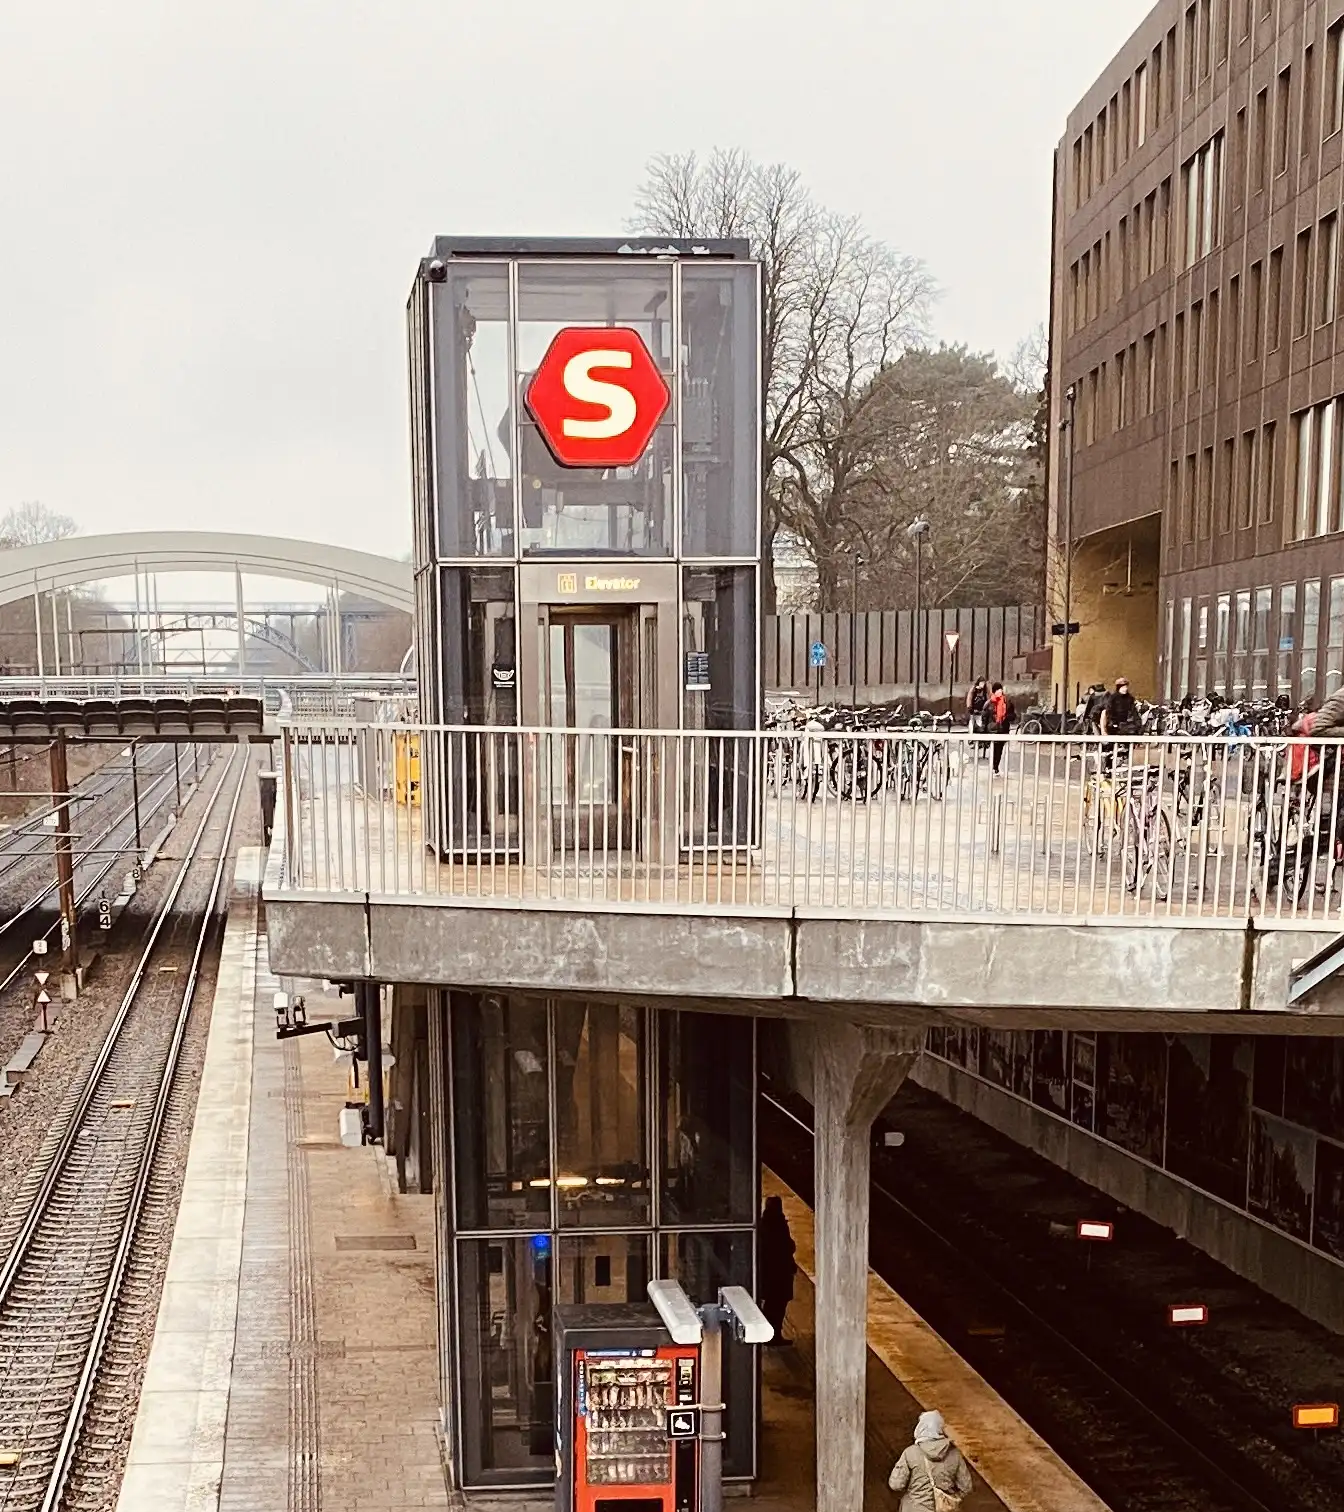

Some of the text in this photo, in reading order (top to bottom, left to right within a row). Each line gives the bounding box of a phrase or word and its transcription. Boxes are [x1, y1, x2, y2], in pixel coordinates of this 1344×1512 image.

[563, 349, 637, 439] S
[99, 900, 109, 913] 6
[100, 915, 110, 928] 4
